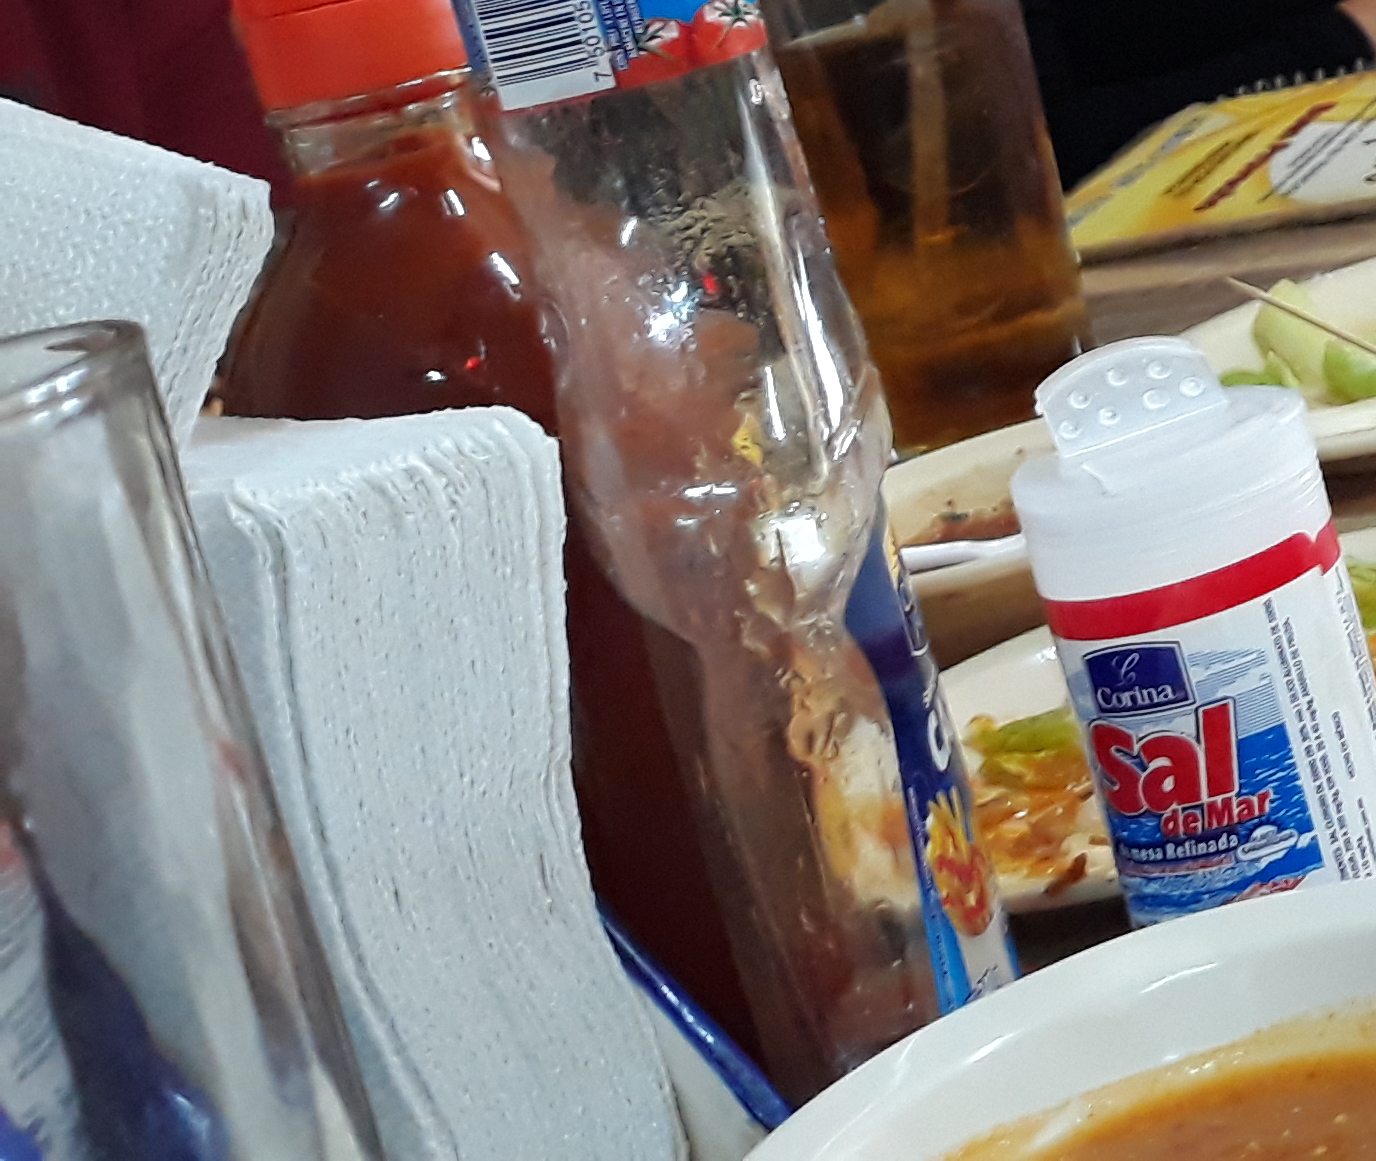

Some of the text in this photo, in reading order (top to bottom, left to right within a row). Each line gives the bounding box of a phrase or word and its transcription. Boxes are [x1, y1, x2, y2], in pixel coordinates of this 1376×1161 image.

[1096, 683, 1178, 710] Corina
[1089, 699, 1237, 816] Sal
[1161, 789, 1272, 837] de Mar
[1165, 832, 1240, 860] Refinada
